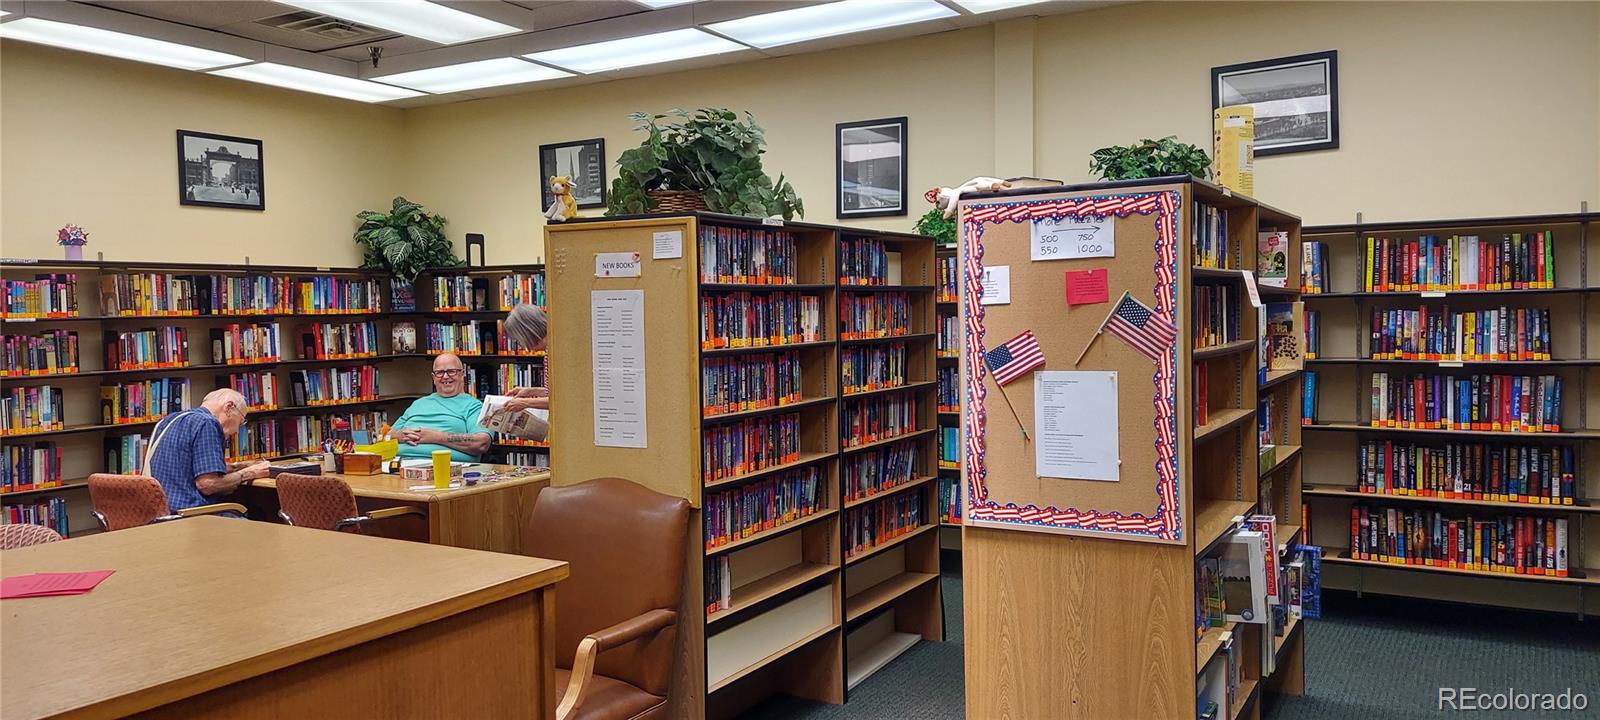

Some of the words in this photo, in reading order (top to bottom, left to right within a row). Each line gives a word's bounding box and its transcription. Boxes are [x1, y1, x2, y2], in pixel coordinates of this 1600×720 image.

[1040, 235, 1058, 244] 500
[1078, 234, 1094, 242] 750
[1040, 246, 1058, 255] 550
[1078, 245, 1103, 253] 1000
[1464, 483, 1471, 491] 21
